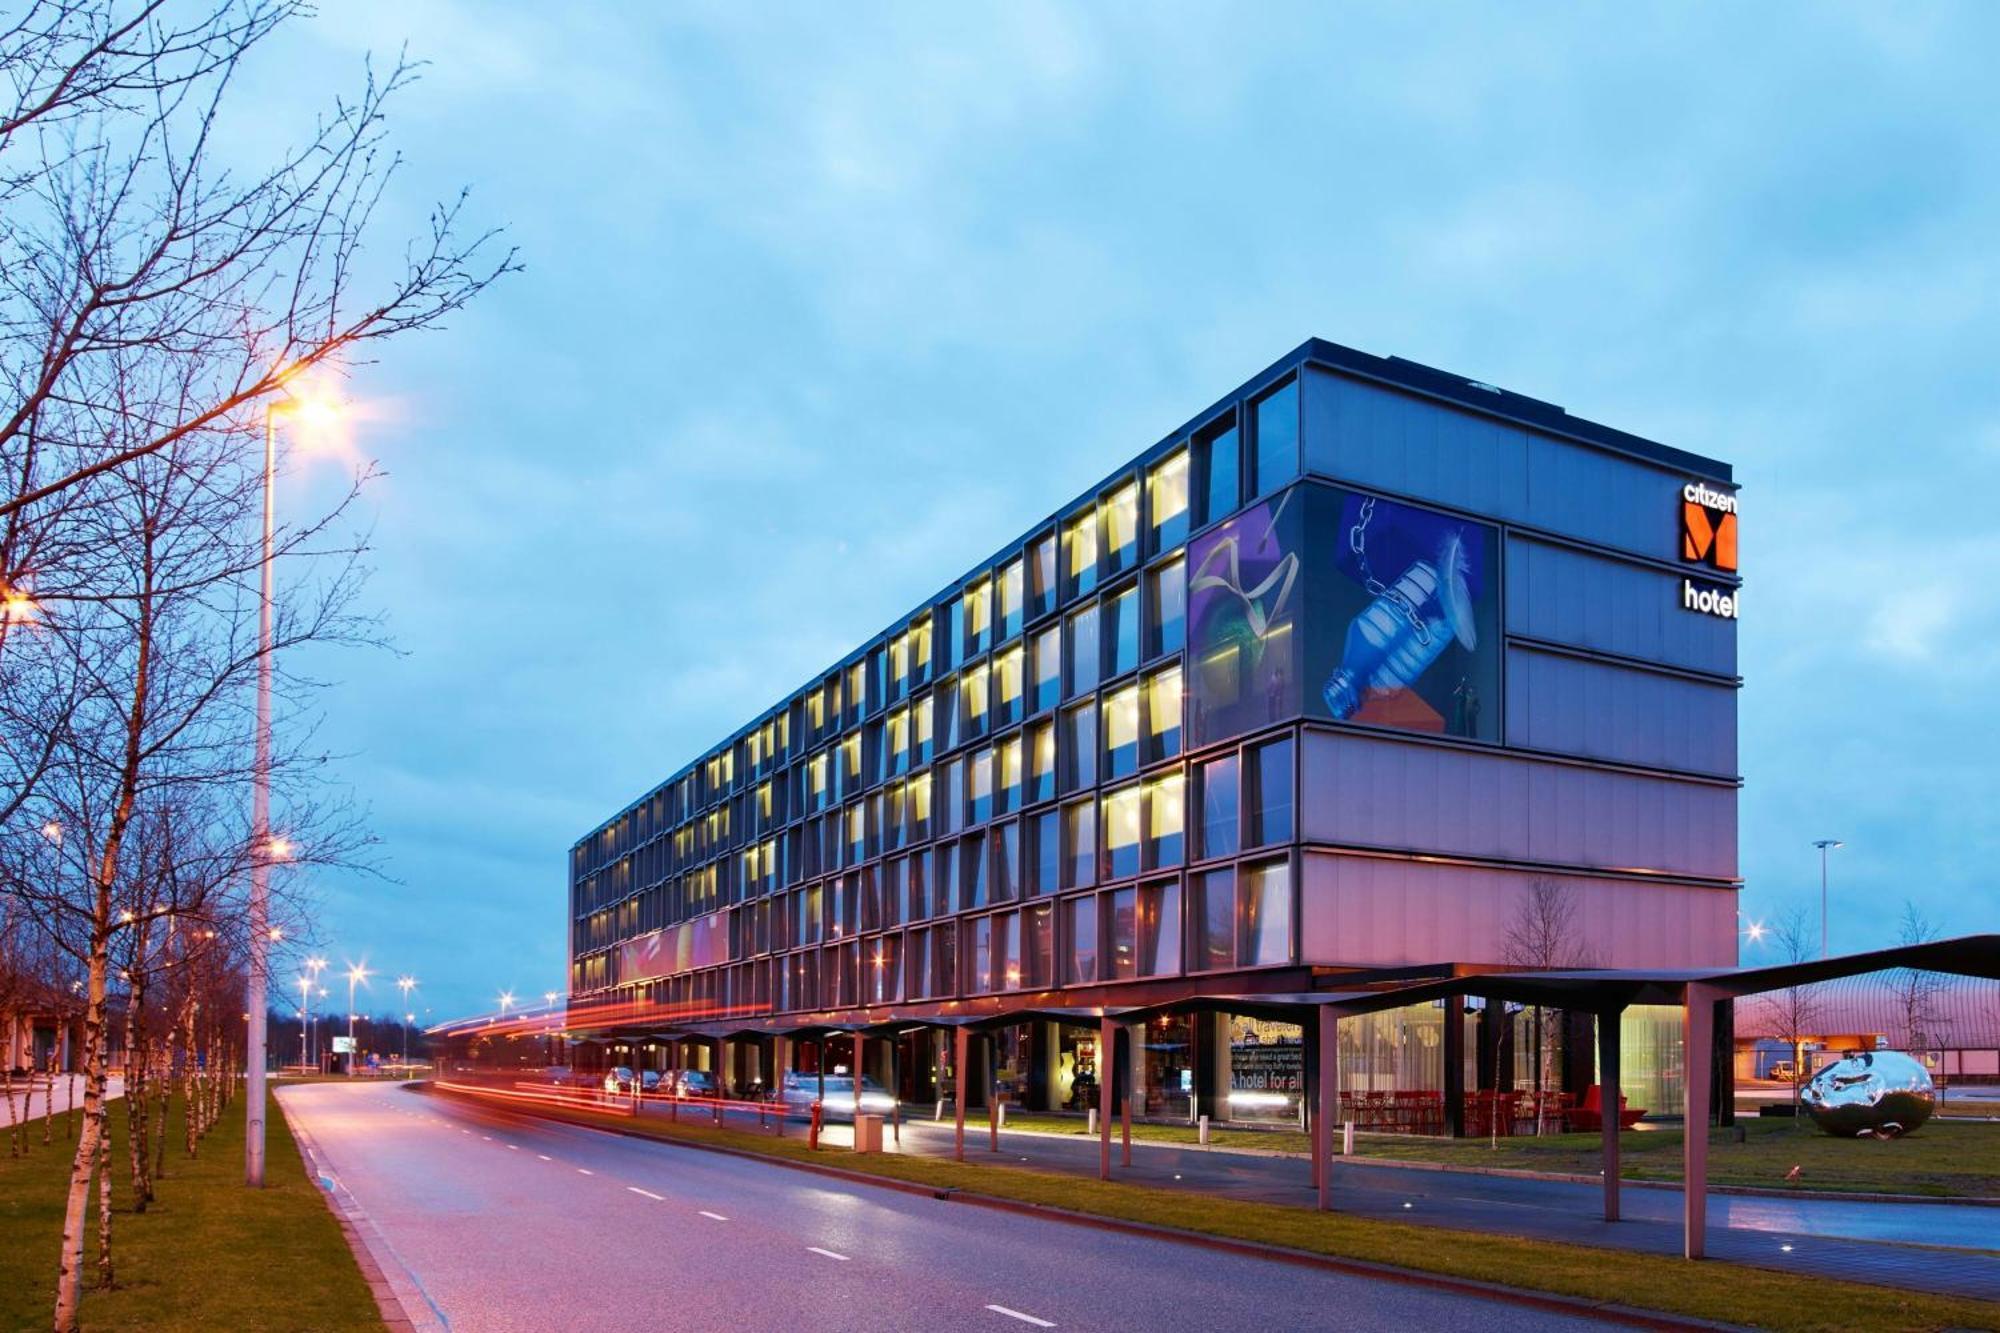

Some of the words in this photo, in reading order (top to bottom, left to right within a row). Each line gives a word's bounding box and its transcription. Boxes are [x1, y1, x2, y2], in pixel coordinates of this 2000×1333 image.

[1684, 483, 1737, 513] citizen
[1684, 579, 1738, 618] hotel
[1239, 1071, 1267, 1089] hotel
[1270, 1072, 1287, 1089] for
[1288, 1072, 1303, 1090] all
